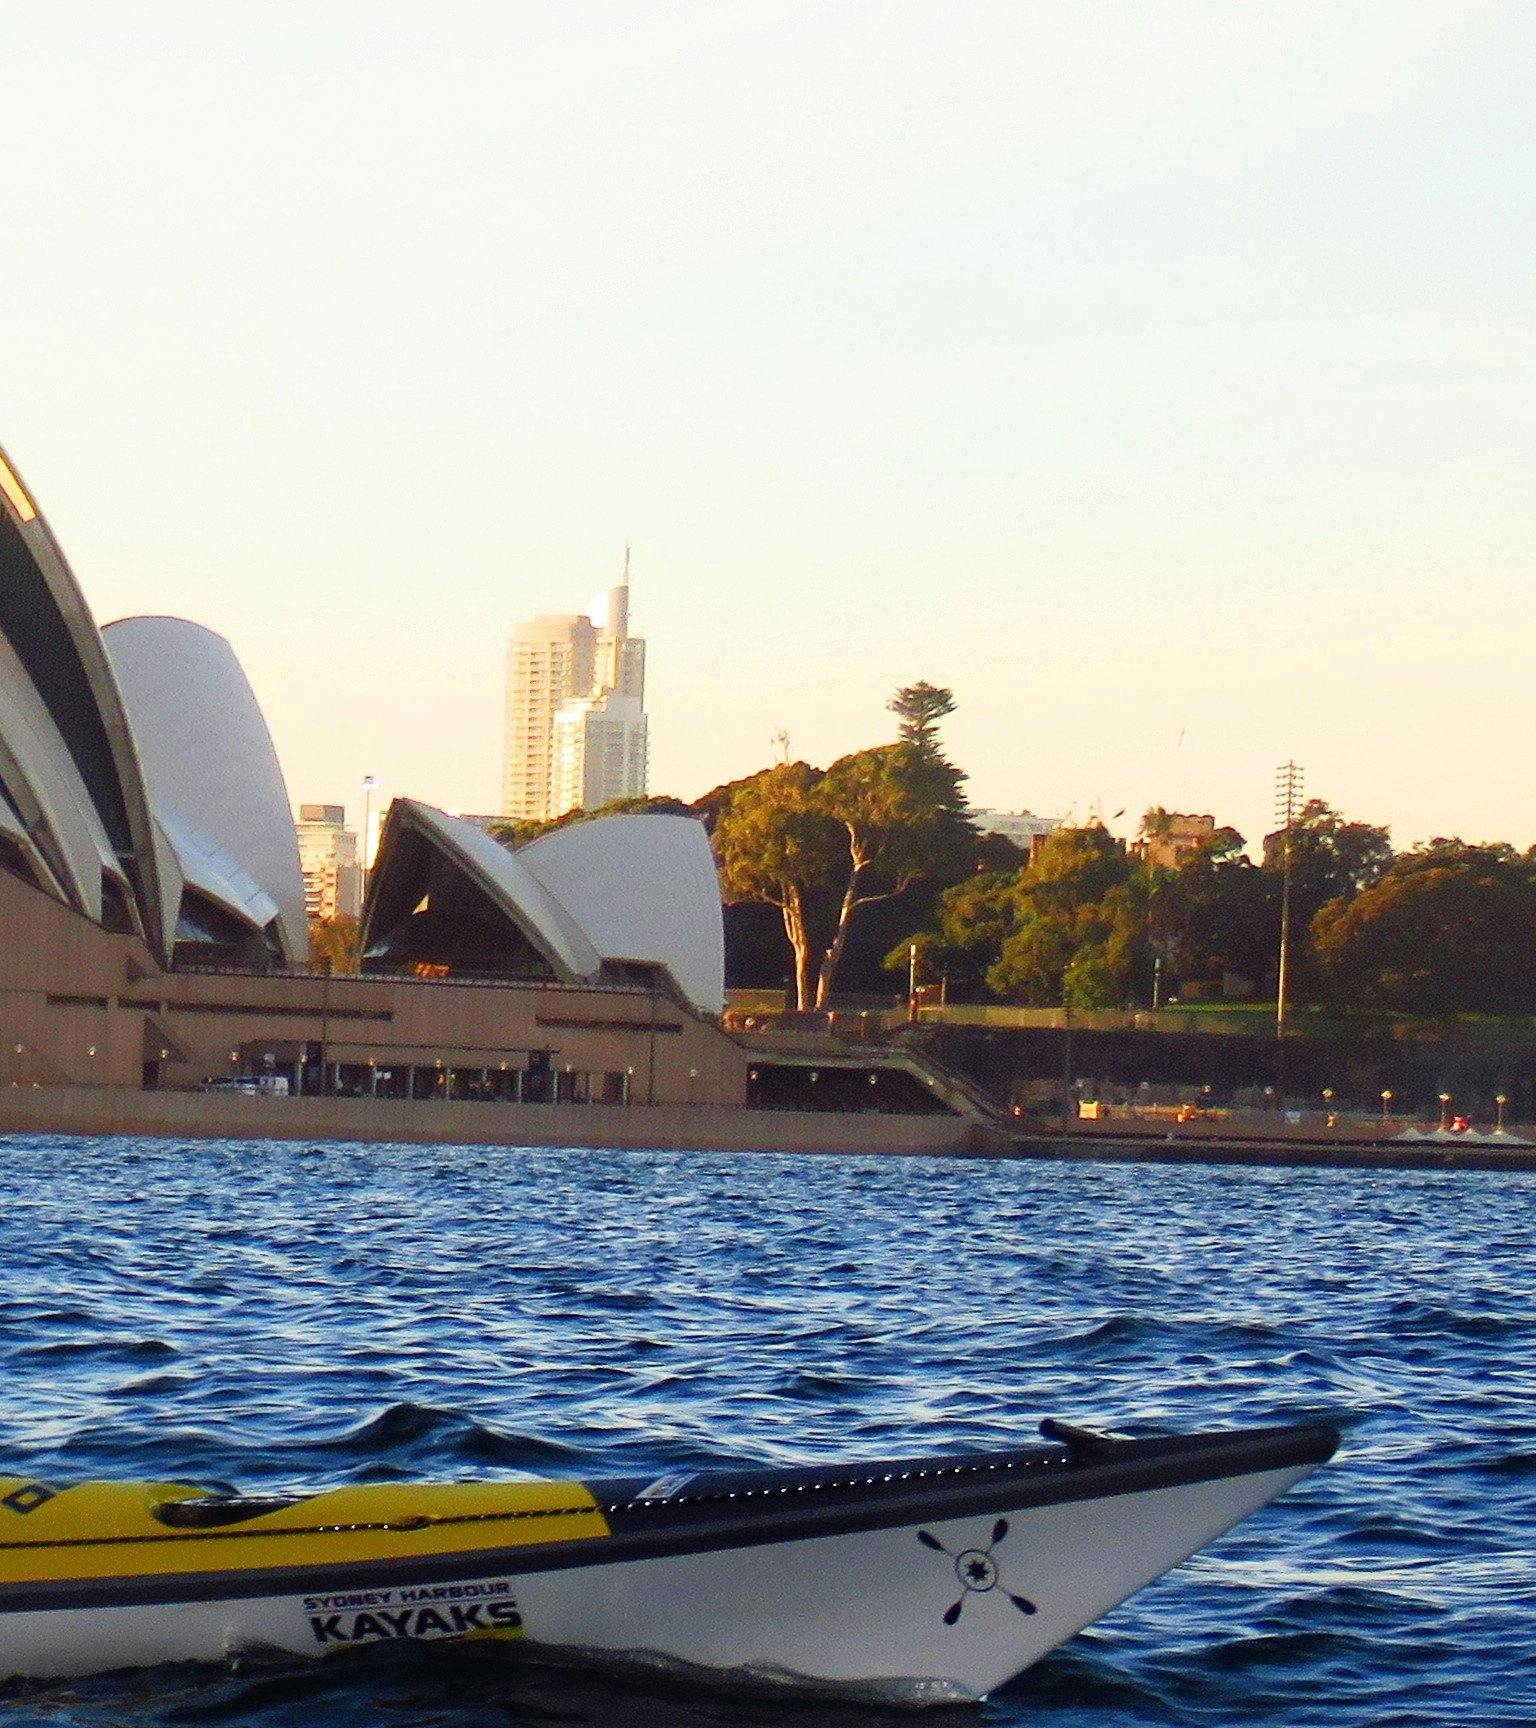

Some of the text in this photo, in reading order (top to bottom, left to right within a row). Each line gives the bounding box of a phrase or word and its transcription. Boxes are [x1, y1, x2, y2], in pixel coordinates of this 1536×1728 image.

[303, 1582, 510, 1611] SYDNEY HARBOUR
[310, 1601, 523, 1643] KAYAKS
